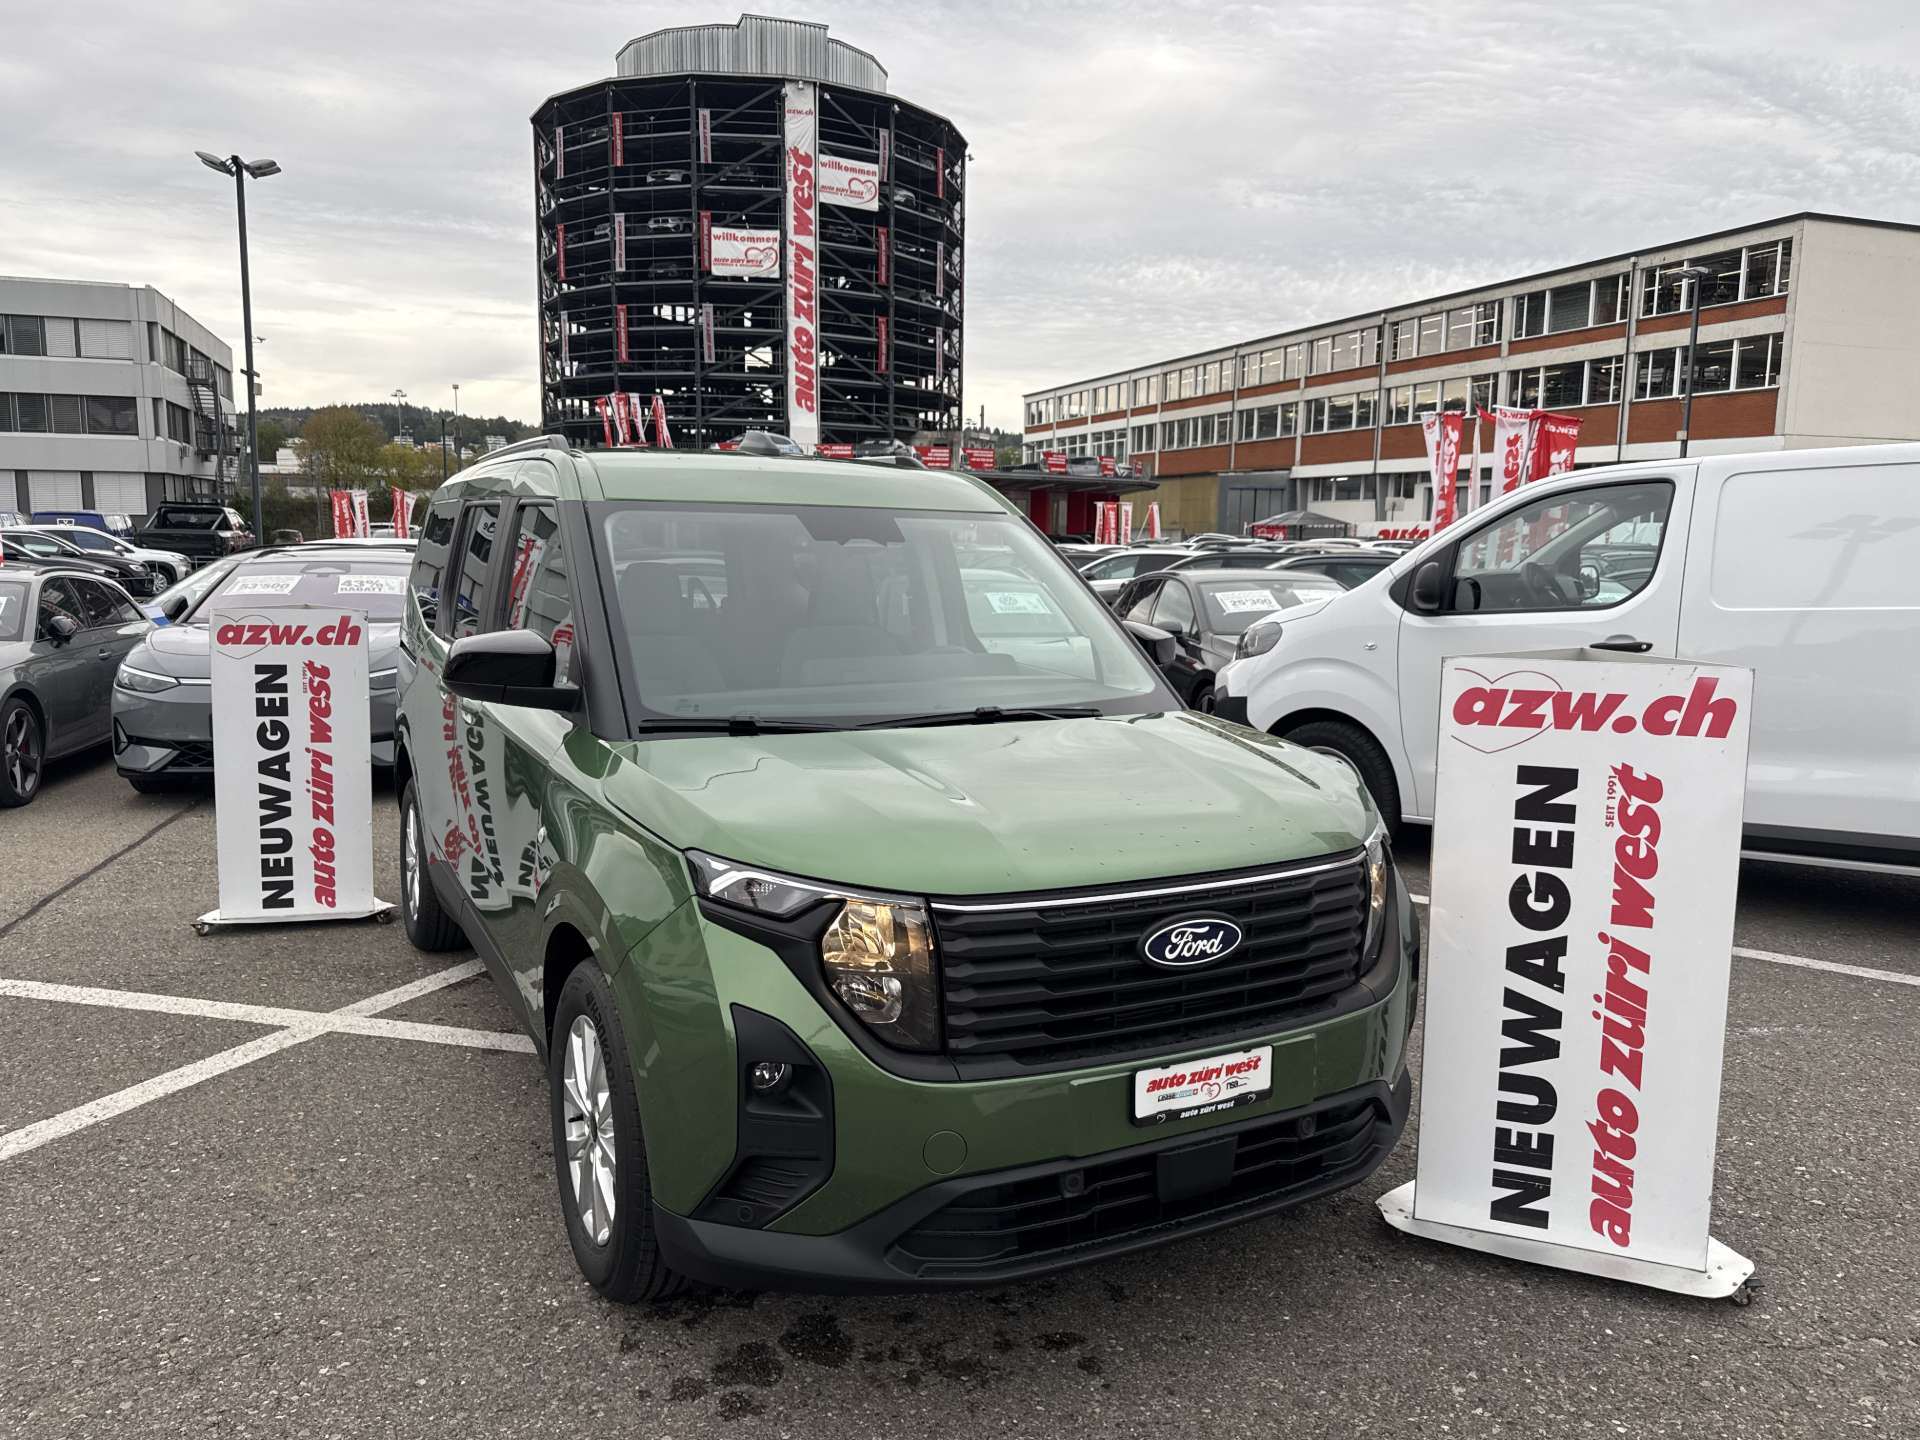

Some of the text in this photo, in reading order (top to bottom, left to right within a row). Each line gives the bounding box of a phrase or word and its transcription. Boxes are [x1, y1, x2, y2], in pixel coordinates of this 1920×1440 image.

[786, 107, 814, 117] azw.ch
[820, 160, 877, 177] willkommen
[712, 231, 778, 244] willkommen
[788, 145, 815, 414] auto züri west
[216, 615, 362, 646] azw.ch
[1452, 676, 1738, 740] azw.ch
[254, 664, 294, 910] NEUWAGEN
[302, 659, 337, 909] auto züri west
[1605, 775, 1617, 828] SEIT 1991
[1164, 925, 1224, 960] Ford
[1489, 764, 1580, 1230] NEUWAGEN
[1584, 762, 1665, 1248] auto züri west
[1146, 1055, 1262, 1093] auto züri west
[1180, 1108, 1198, 1119] auto
[1217, 1100, 1235, 1110] west
